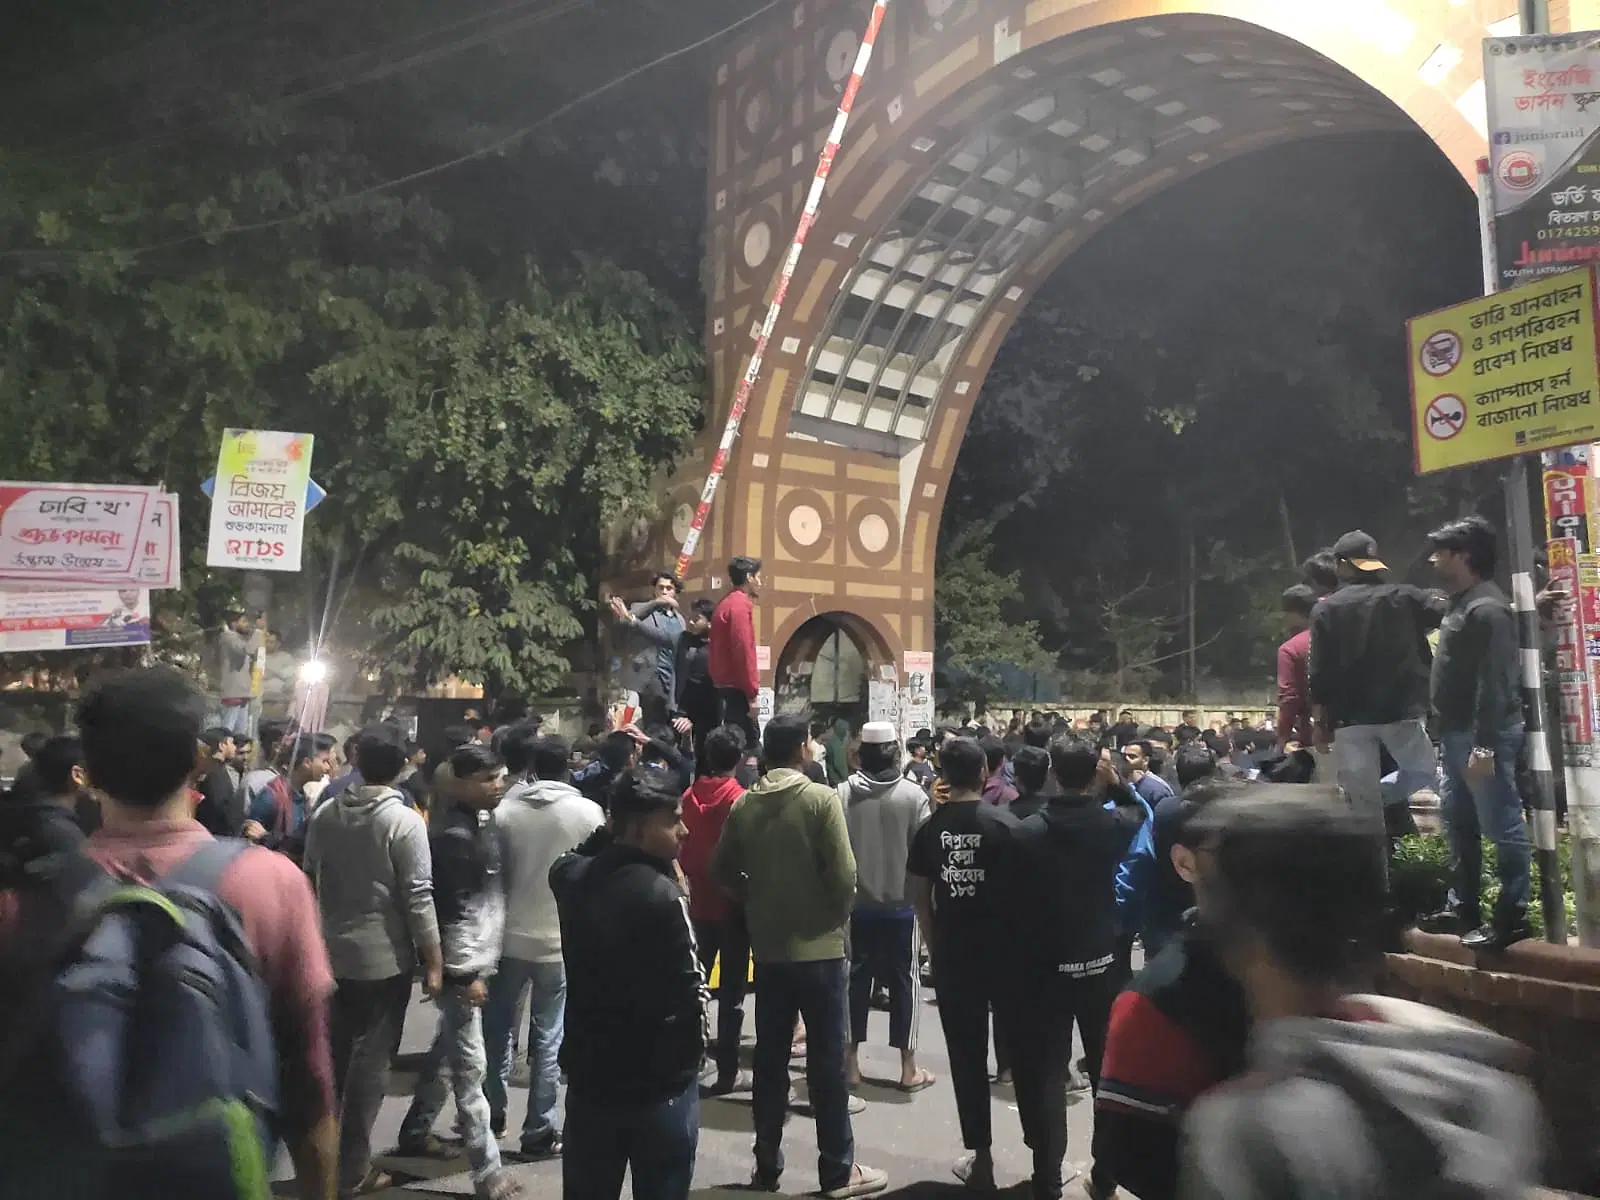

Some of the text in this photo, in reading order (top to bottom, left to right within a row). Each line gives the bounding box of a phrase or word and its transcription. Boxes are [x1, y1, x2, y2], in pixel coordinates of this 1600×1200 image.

[1551, 185, 1587, 206] ভর্তি
[1537, 225, 1600, 240] 0174259
[1503, 268, 1534, 279] SOUTH
[1469, 284, 1583, 329] ভারি যানবাহন
[1472, 309, 1581, 351] ও গণপরিবহন
[1473, 335, 1574, 376] প্রবেশ নিষেধ
[1475, 368, 1572, 406] ক্যাম্পাসে হর্ন
[1476, 390, 1592, 428] বাজানো নিষেধ
[230, 474, 287, 500] বিজয়
[39, 496, 88, 515] ঢাবি
[225, 538, 285, 557] RTDS
